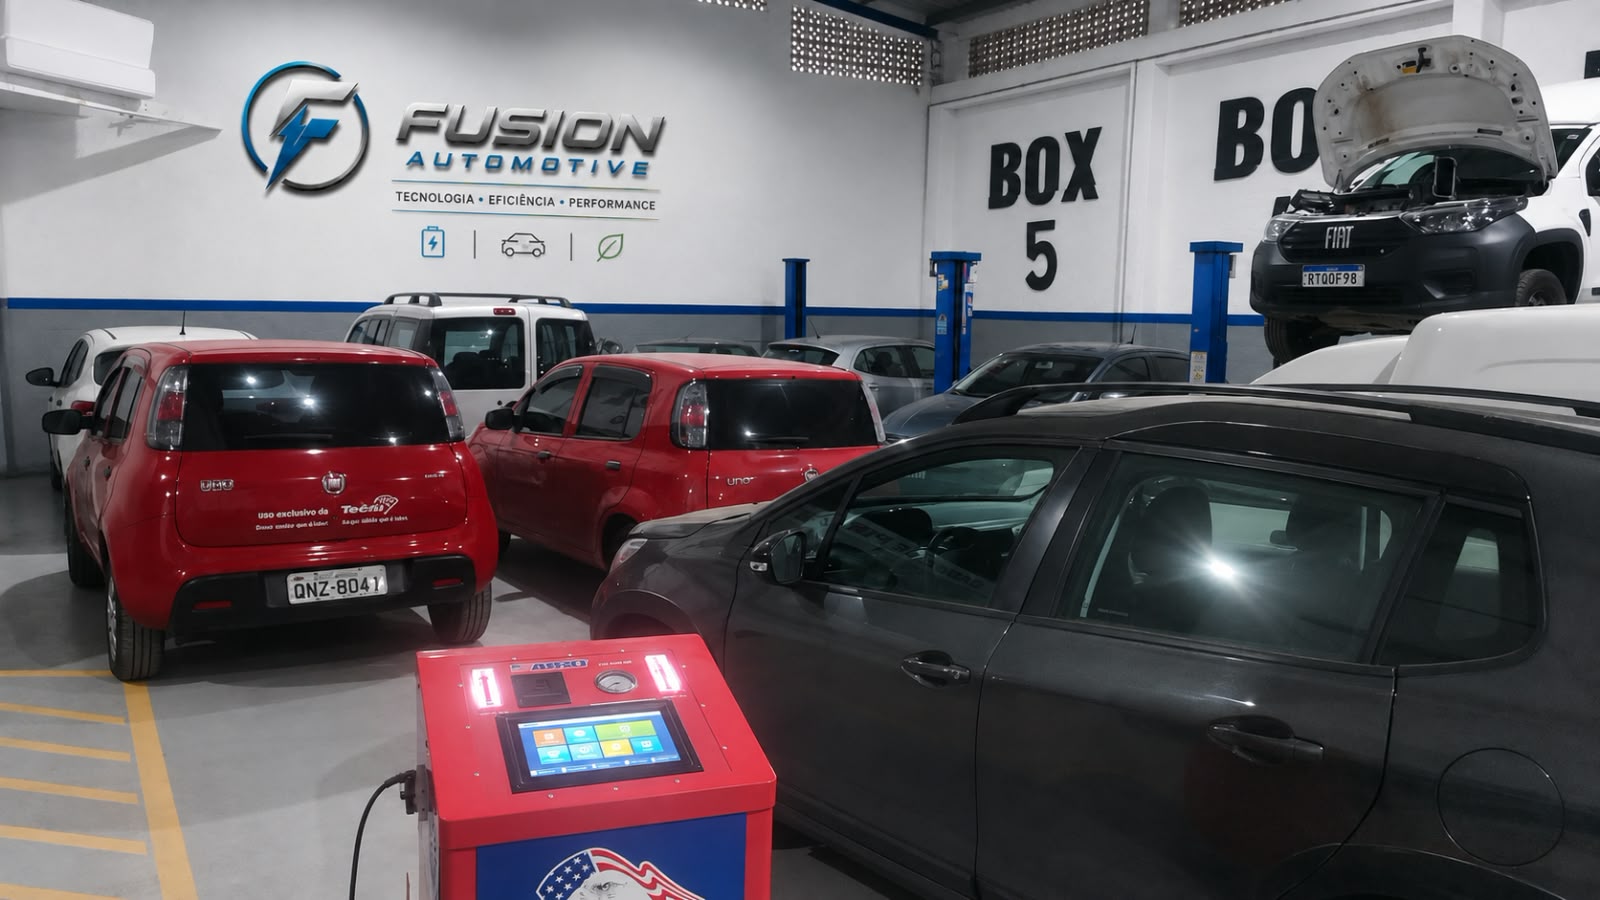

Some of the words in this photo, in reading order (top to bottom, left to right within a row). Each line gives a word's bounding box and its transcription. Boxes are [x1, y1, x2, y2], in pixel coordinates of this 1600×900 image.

[395, 101, 667, 154] FUSION
[1213, 86, 1321, 181] BO
[405, 151, 650, 176] AUTOMOTIVE
[988, 126, 1103, 210] BOX
[395, 191, 475, 206] TECNOLOGIA
[488, 193, 556, 208] EFICIÊNCIA
[569, 197, 657, 211] PERFORMANCE
[1324, 225, 1355, 249] FIAT
[1025, 219, 1058, 291] 5
[257, 511, 275, 519] uso
[276, 508, 317, 518] exclusivo
[293, 576, 380, 599] QNZ-8041
